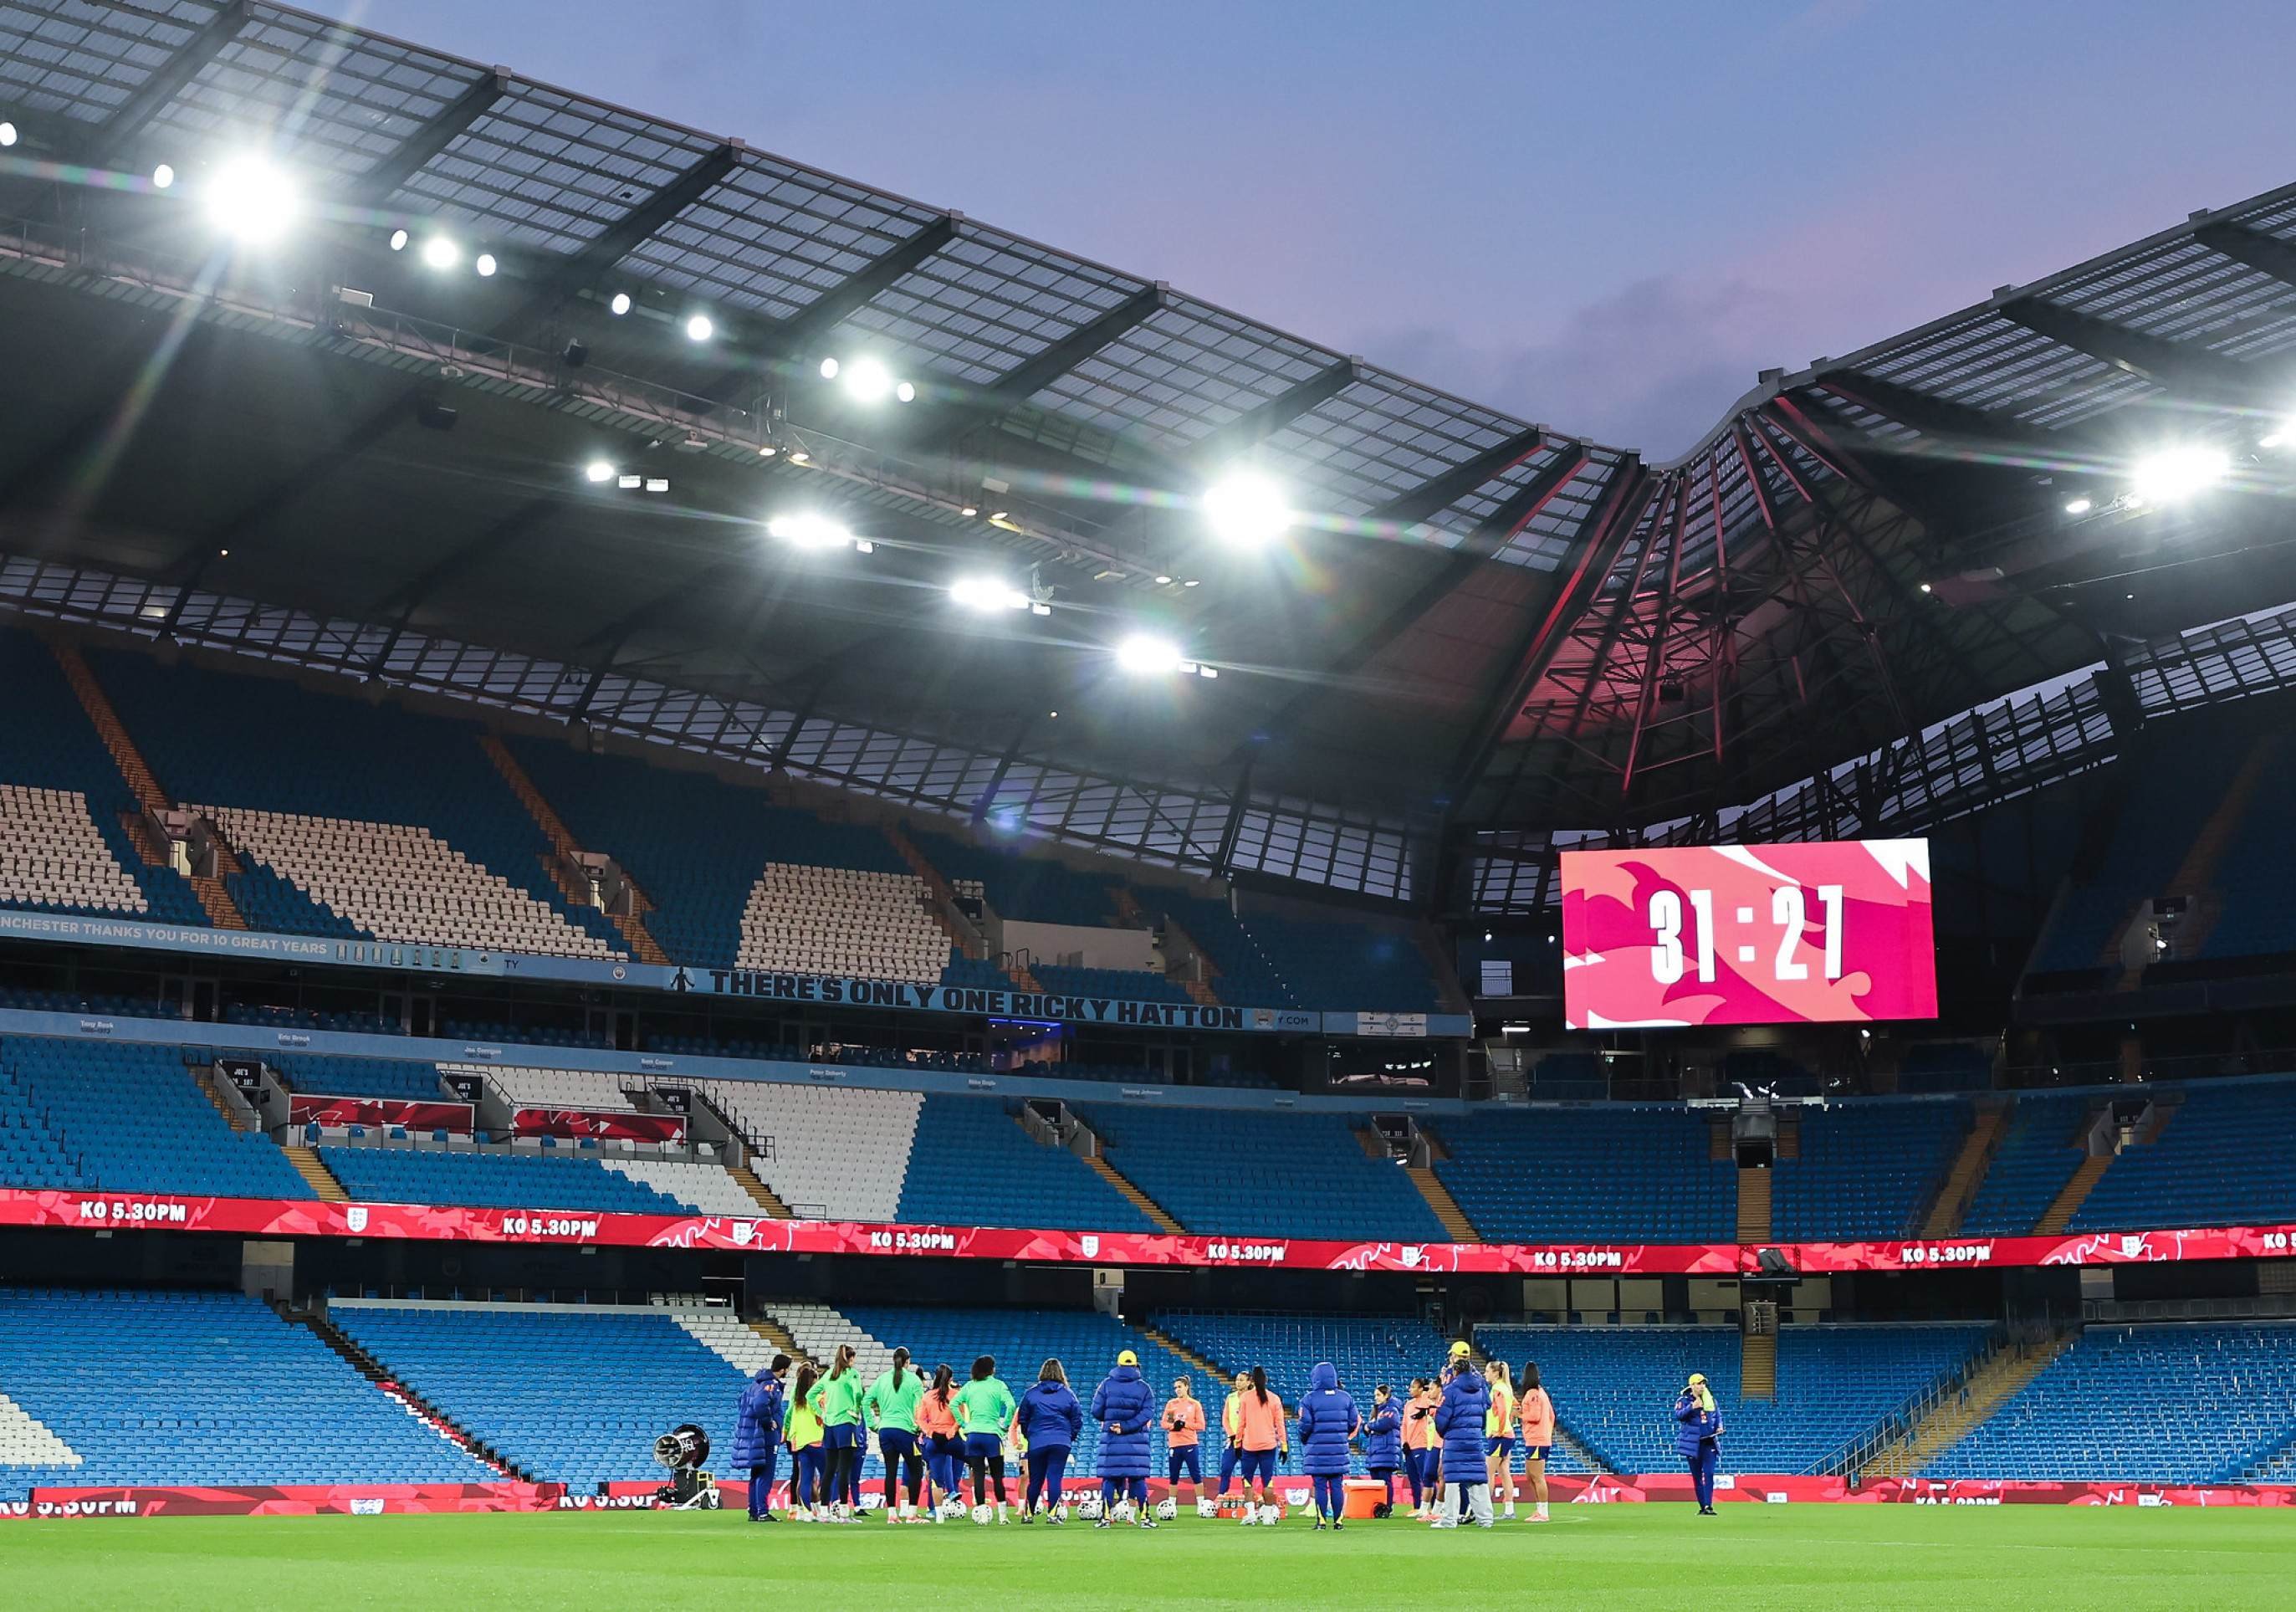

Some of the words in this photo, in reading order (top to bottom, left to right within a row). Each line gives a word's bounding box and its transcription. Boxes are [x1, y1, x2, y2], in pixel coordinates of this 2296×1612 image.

[84, 923, 141, 938] THANKS
[146, 929, 176, 941] YOU
[181, 932, 209, 944] FOR
[213, 934, 228, 946] 10
[232, 937, 278, 950] GREAT
[282, 940, 327, 954] YEARS
[709, 970, 842, 1002] THERE'S
[849, 980, 936, 1008] ONLY
[943, 988, 1005, 1013] ONE
[1011, 993, 1111, 1021] RICKY
[1117, 1001, 1244, 1029] HATTON
[80, 1201, 106, 1219] KO
[111, 1202, 186, 1221] 5.30PM
[503, 1217, 527, 1234] KO
[530, 1219, 596, 1237] 5.30PM
[870, 1231, 892, 1247] KO
[895, 1232, 954, 1250] 5.30PM
[2263, 1232, 2287, 1249] KO
[1208, 1244, 1228, 1259] KO
[1230, 1245, 1285, 1261] 5.30PM
[1533, 1251, 1557, 1267] KO
[1560, 1251, 1621, 1267] 5.30PM
[1902, 1247, 1925, 1262] KO
[1929, 1246, 1991, 1262] 5.30PM
